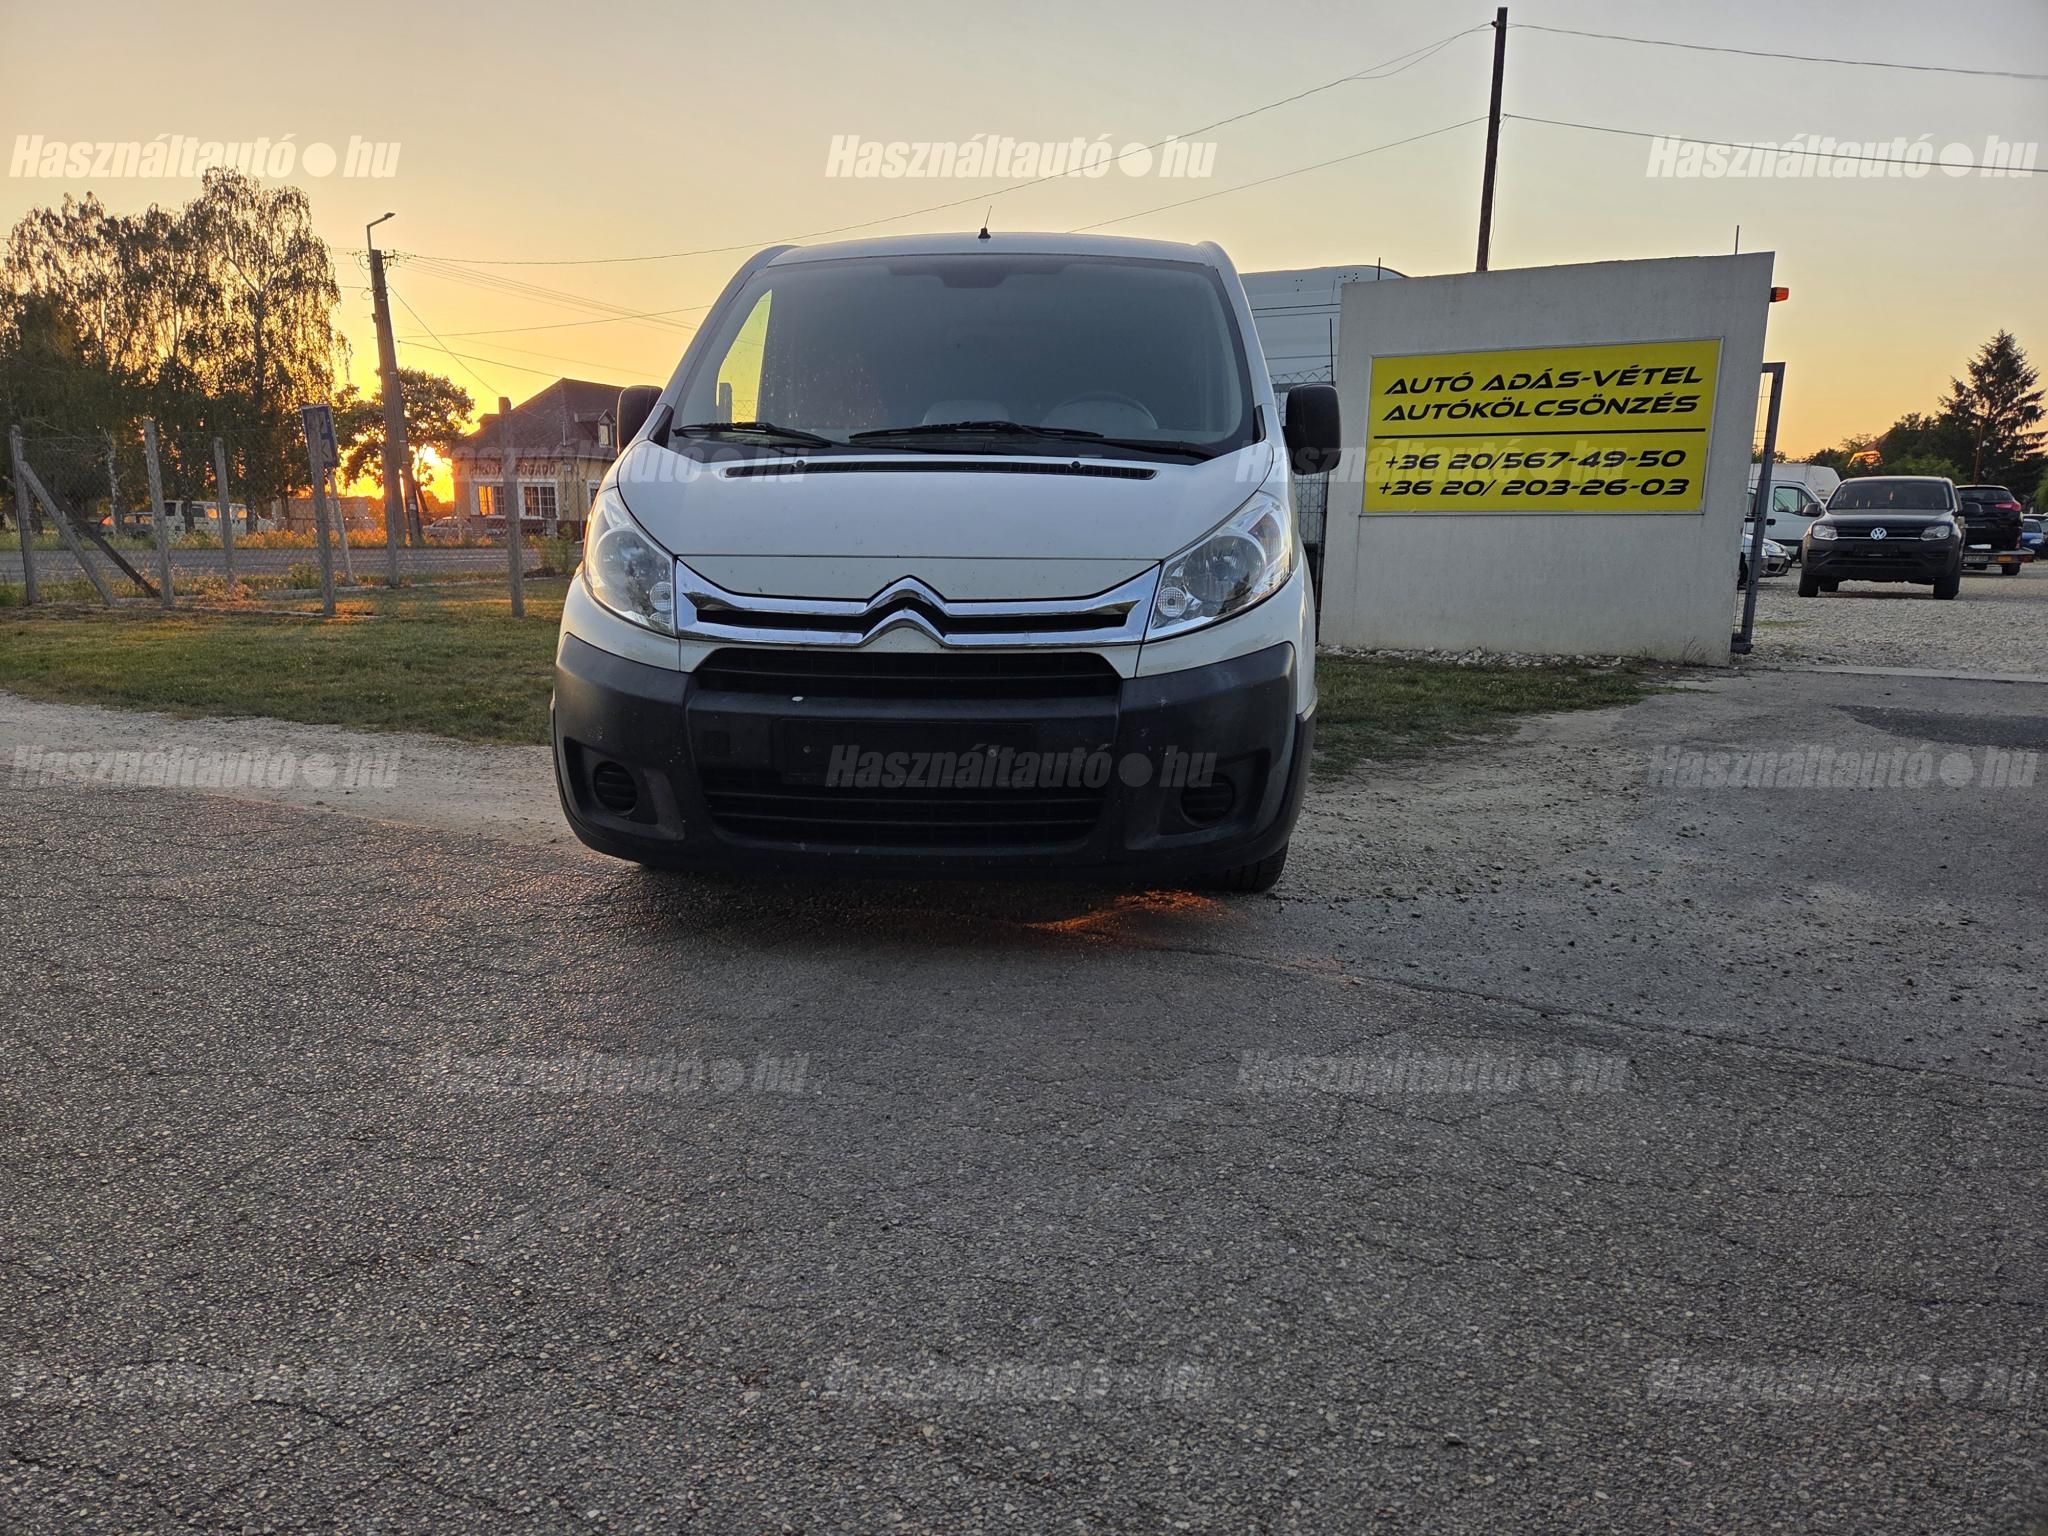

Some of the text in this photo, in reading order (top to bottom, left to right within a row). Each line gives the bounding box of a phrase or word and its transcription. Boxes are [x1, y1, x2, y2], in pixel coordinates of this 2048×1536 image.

[1384, 364, 1703, 395] AUTÓ ADÁS-VÉTEL
[1381, 392, 1701, 421] AUTÓKÖLCSÖNZÉS
[1385, 450, 1686, 470] +36 20/567-49-50
[1379, 480, 1434, 495] +36
[1501, 478, 1690, 496] 203-26-03
